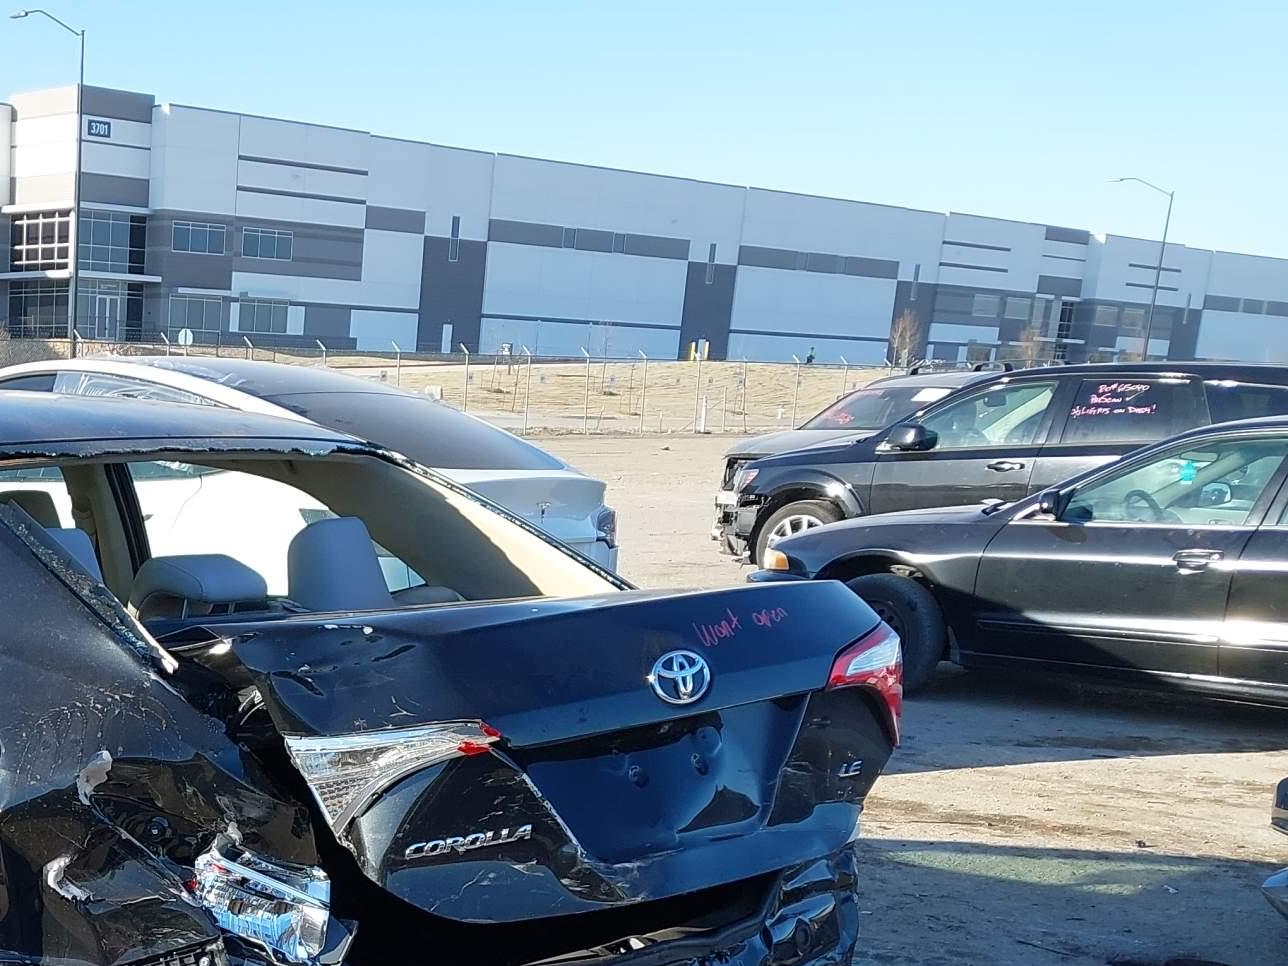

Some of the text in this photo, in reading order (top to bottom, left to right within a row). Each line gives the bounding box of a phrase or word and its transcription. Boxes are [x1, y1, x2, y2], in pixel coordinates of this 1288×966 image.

[91, 122, 109, 135] 3701
[838, 760, 863, 778] LE
[404, 824, 533, 861] COROLLA
